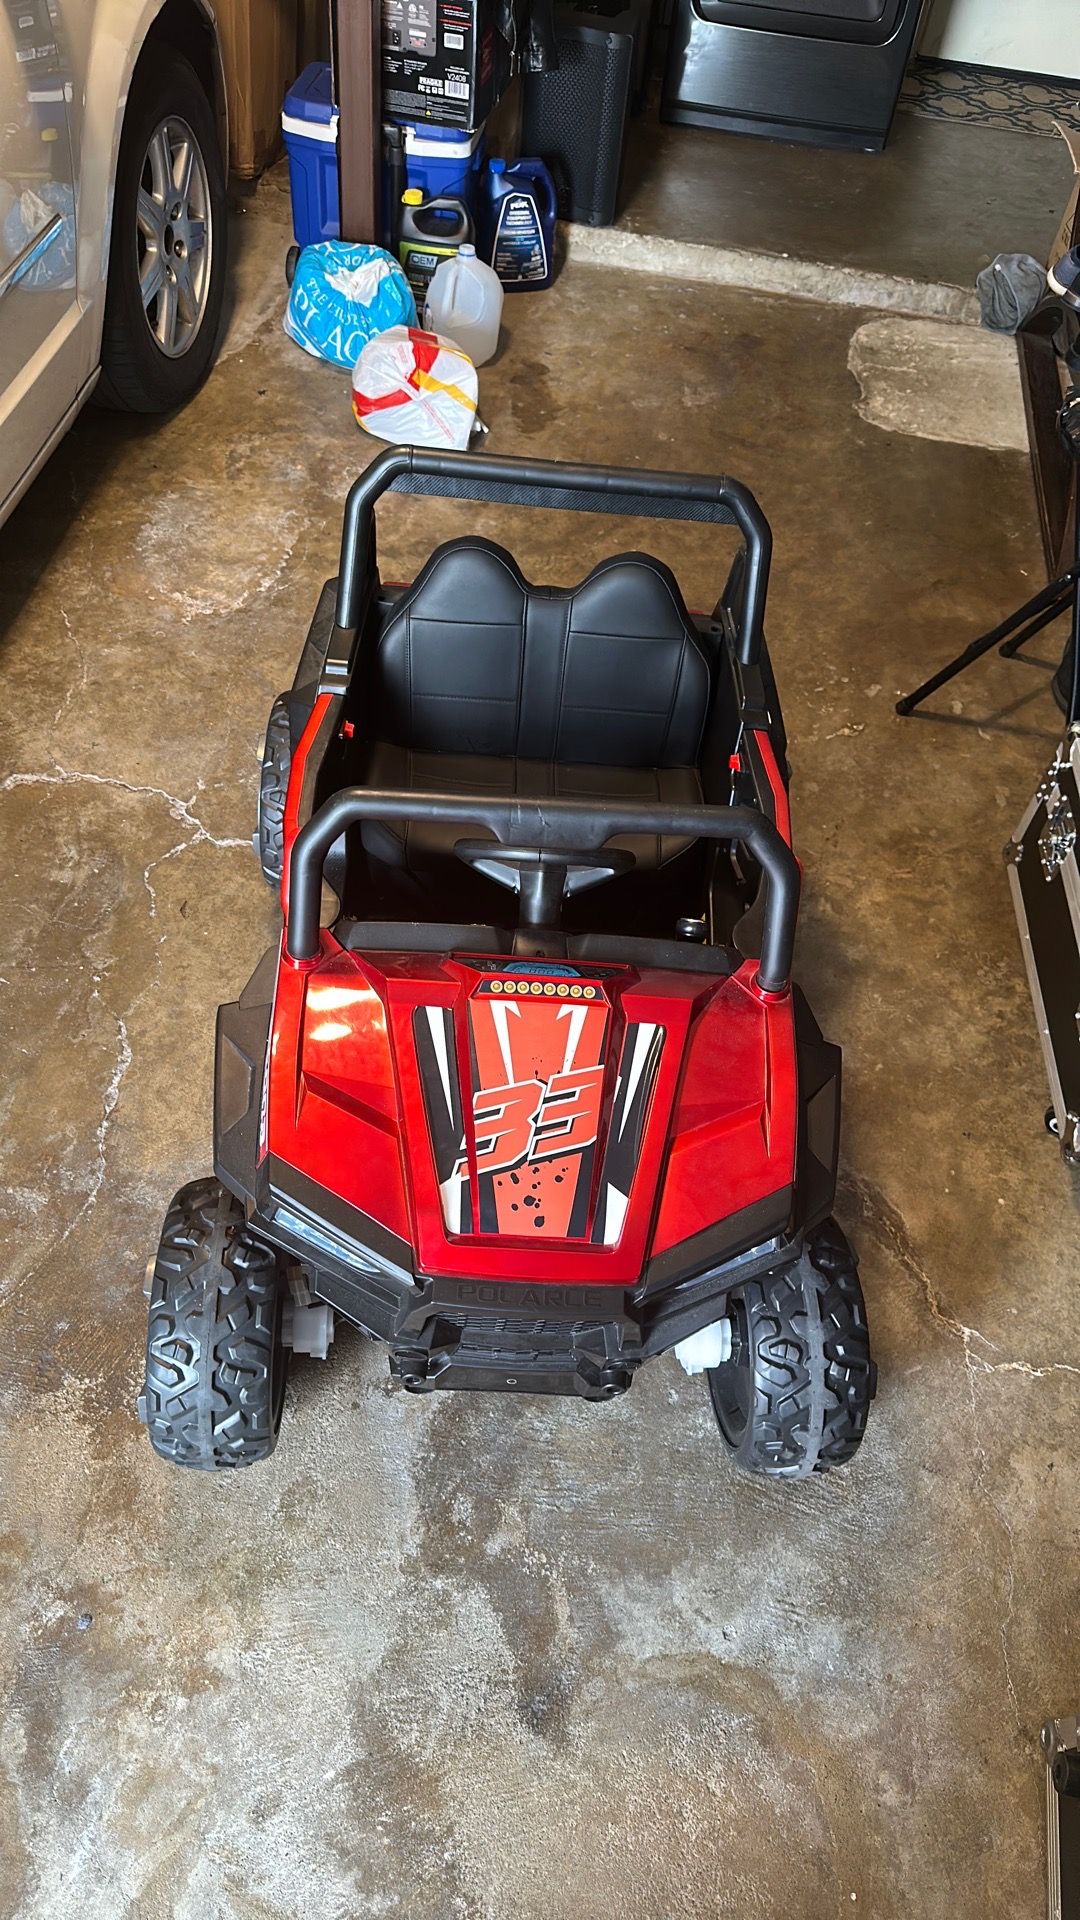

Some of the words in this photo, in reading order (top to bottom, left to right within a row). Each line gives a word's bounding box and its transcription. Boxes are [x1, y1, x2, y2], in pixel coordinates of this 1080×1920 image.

[411, 254, 435, 265] OEM
[294, 284, 381, 363] PLAC
[451, 1064, 605, 1183] 33
